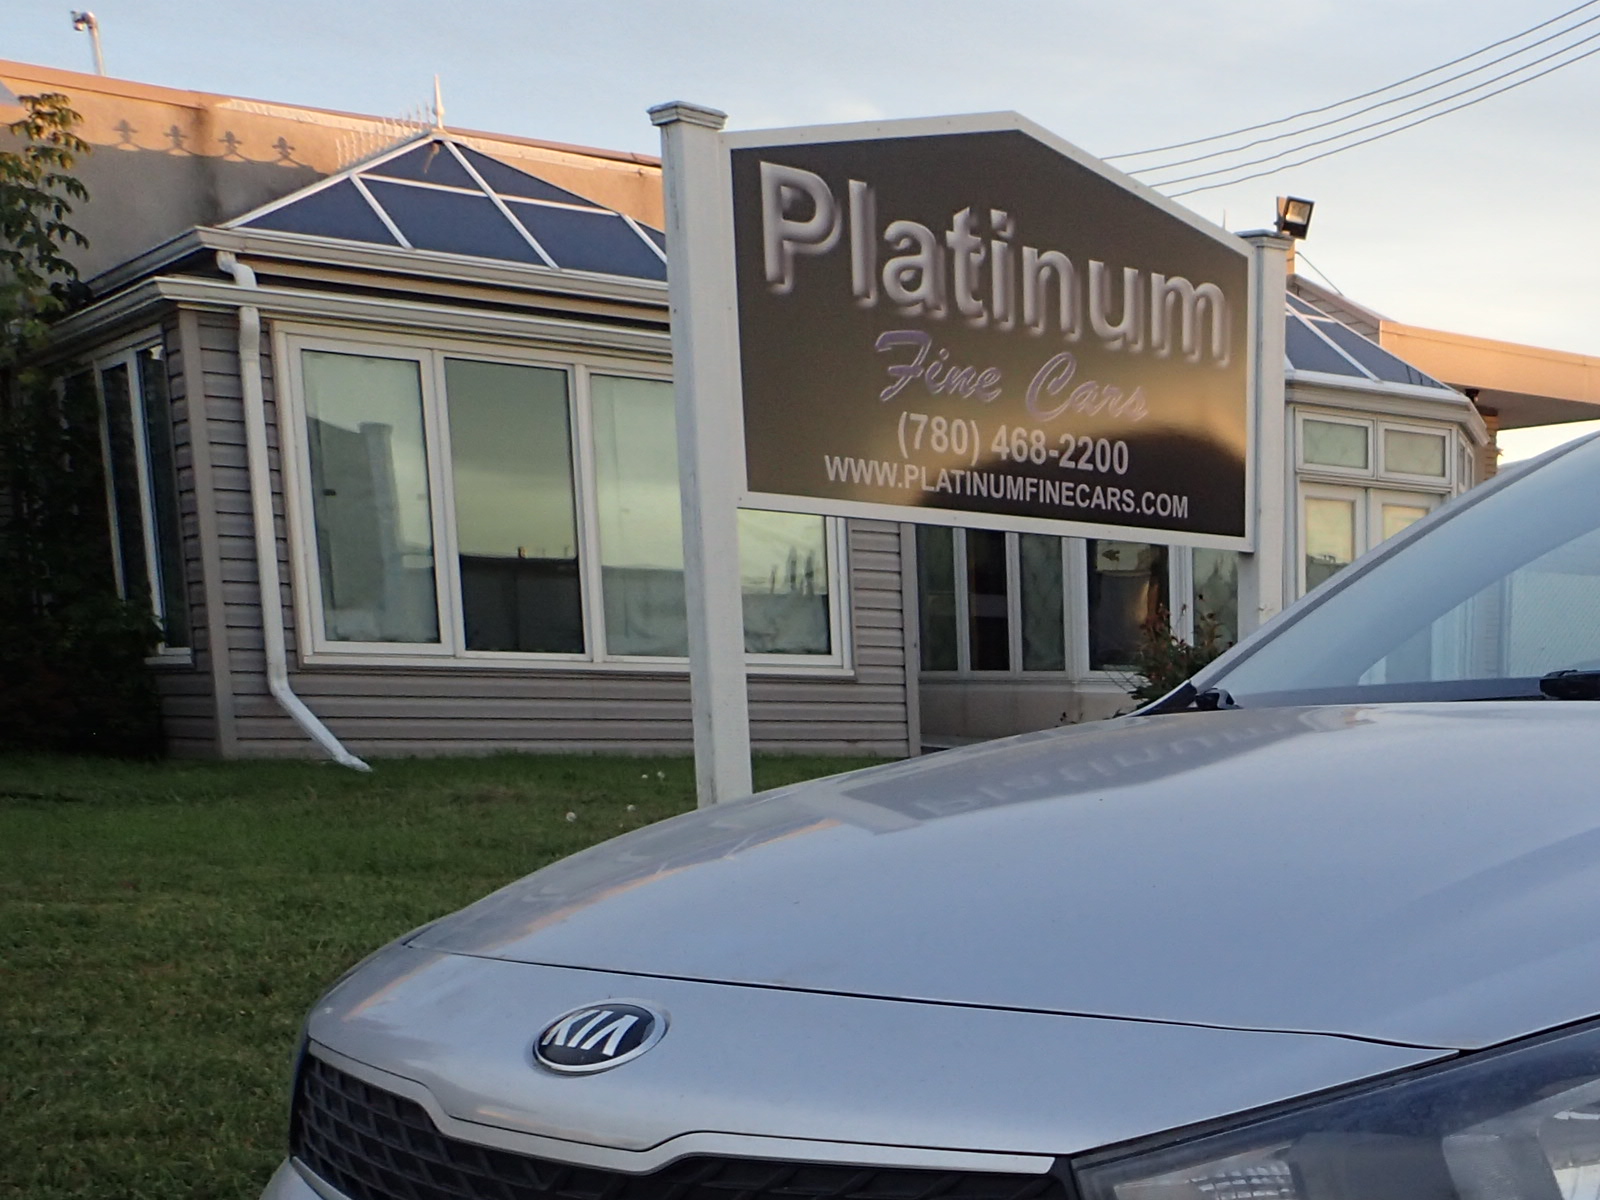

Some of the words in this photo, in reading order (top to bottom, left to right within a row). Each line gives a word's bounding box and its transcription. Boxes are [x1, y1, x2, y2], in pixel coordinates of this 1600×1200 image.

[760, 160, 1230, 366] Platinum
[874, 329, 1002, 402] Fine
[1024, 351, 1150, 422] Cars
[897, 411, 980, 466] (780)
[990, 428, 1130, 475] 468-2200
[823, 454, 1189, 519] WWW.PLATINUMFINECARS.COM
[541, 1009, 639, 1056] KIA
